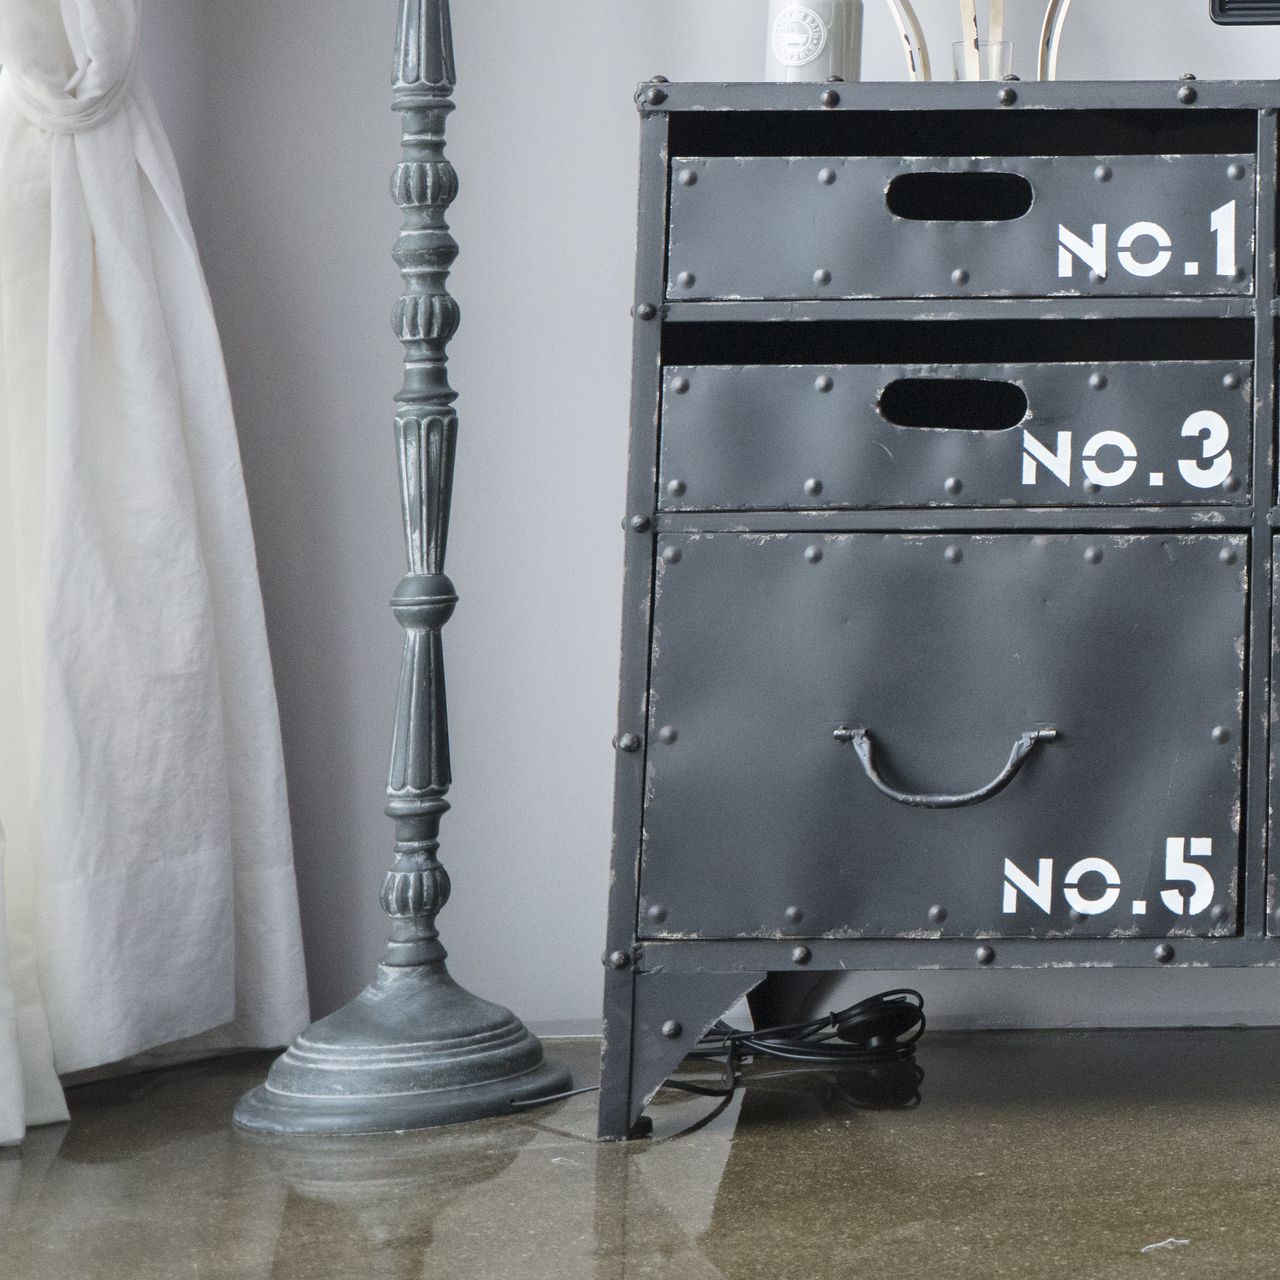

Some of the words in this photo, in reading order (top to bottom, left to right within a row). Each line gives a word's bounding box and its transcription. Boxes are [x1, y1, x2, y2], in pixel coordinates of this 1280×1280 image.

[1056, 198, 1238, 277] NO.1
[1020, 408, 1234, 490] NO.3
[1001, 835, 1216, 917] NO.5
